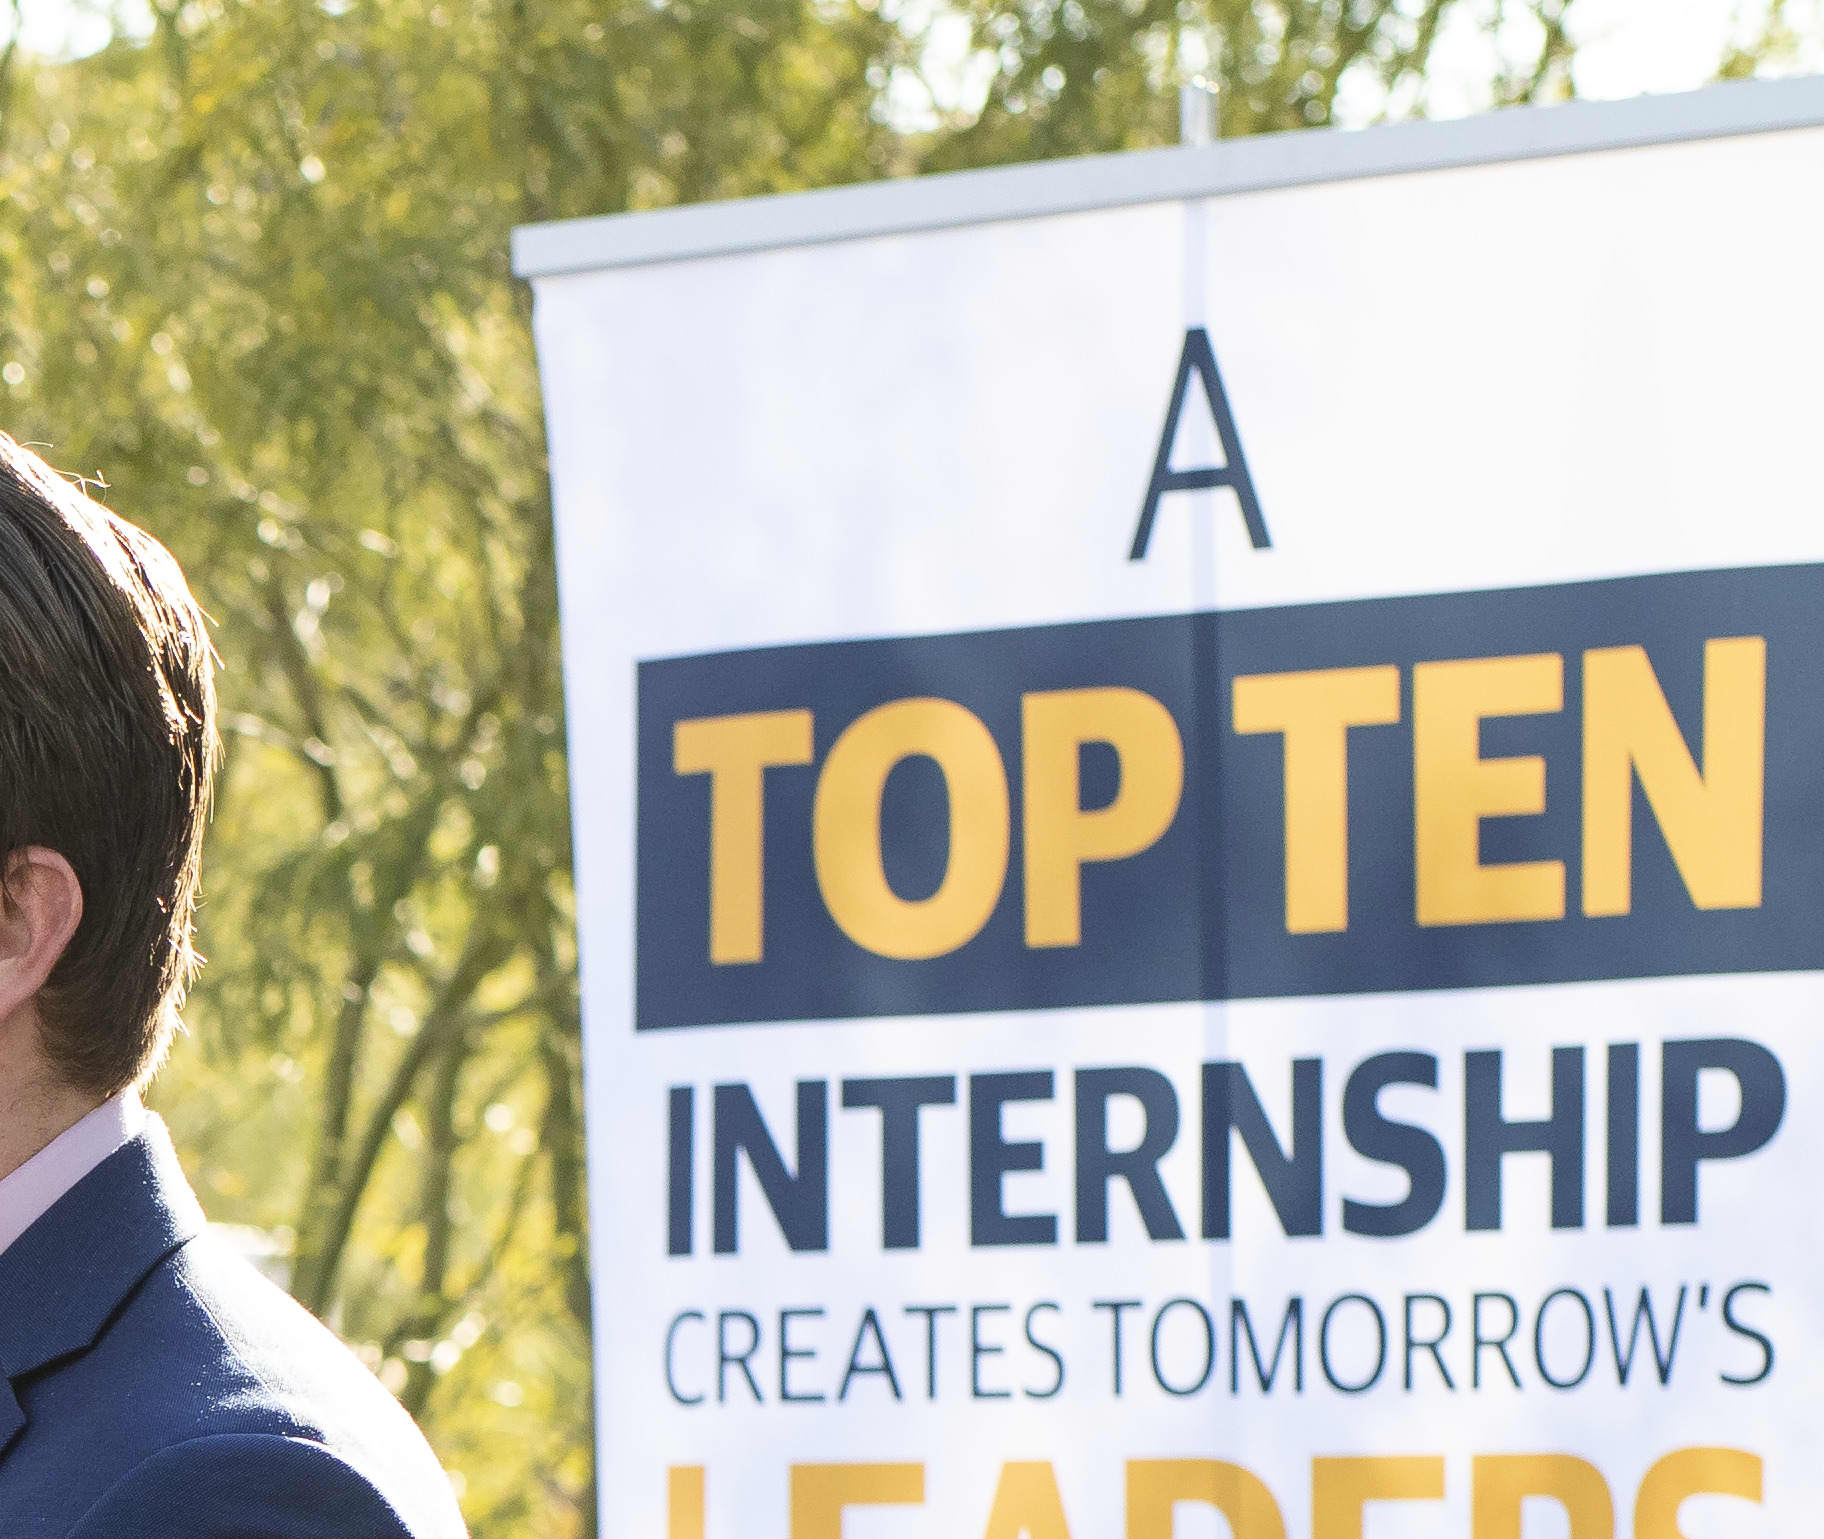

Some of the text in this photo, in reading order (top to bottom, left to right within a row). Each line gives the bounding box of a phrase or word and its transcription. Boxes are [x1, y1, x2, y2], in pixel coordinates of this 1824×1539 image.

[1127, 327, 1273, 561] A
[673, 635, 1767, 966] TOP TEN
[665, 1036, 1788, 1258] INTERNSHIP
[662, 1280, 1778, 1407] CREATES TOMORROW'S
